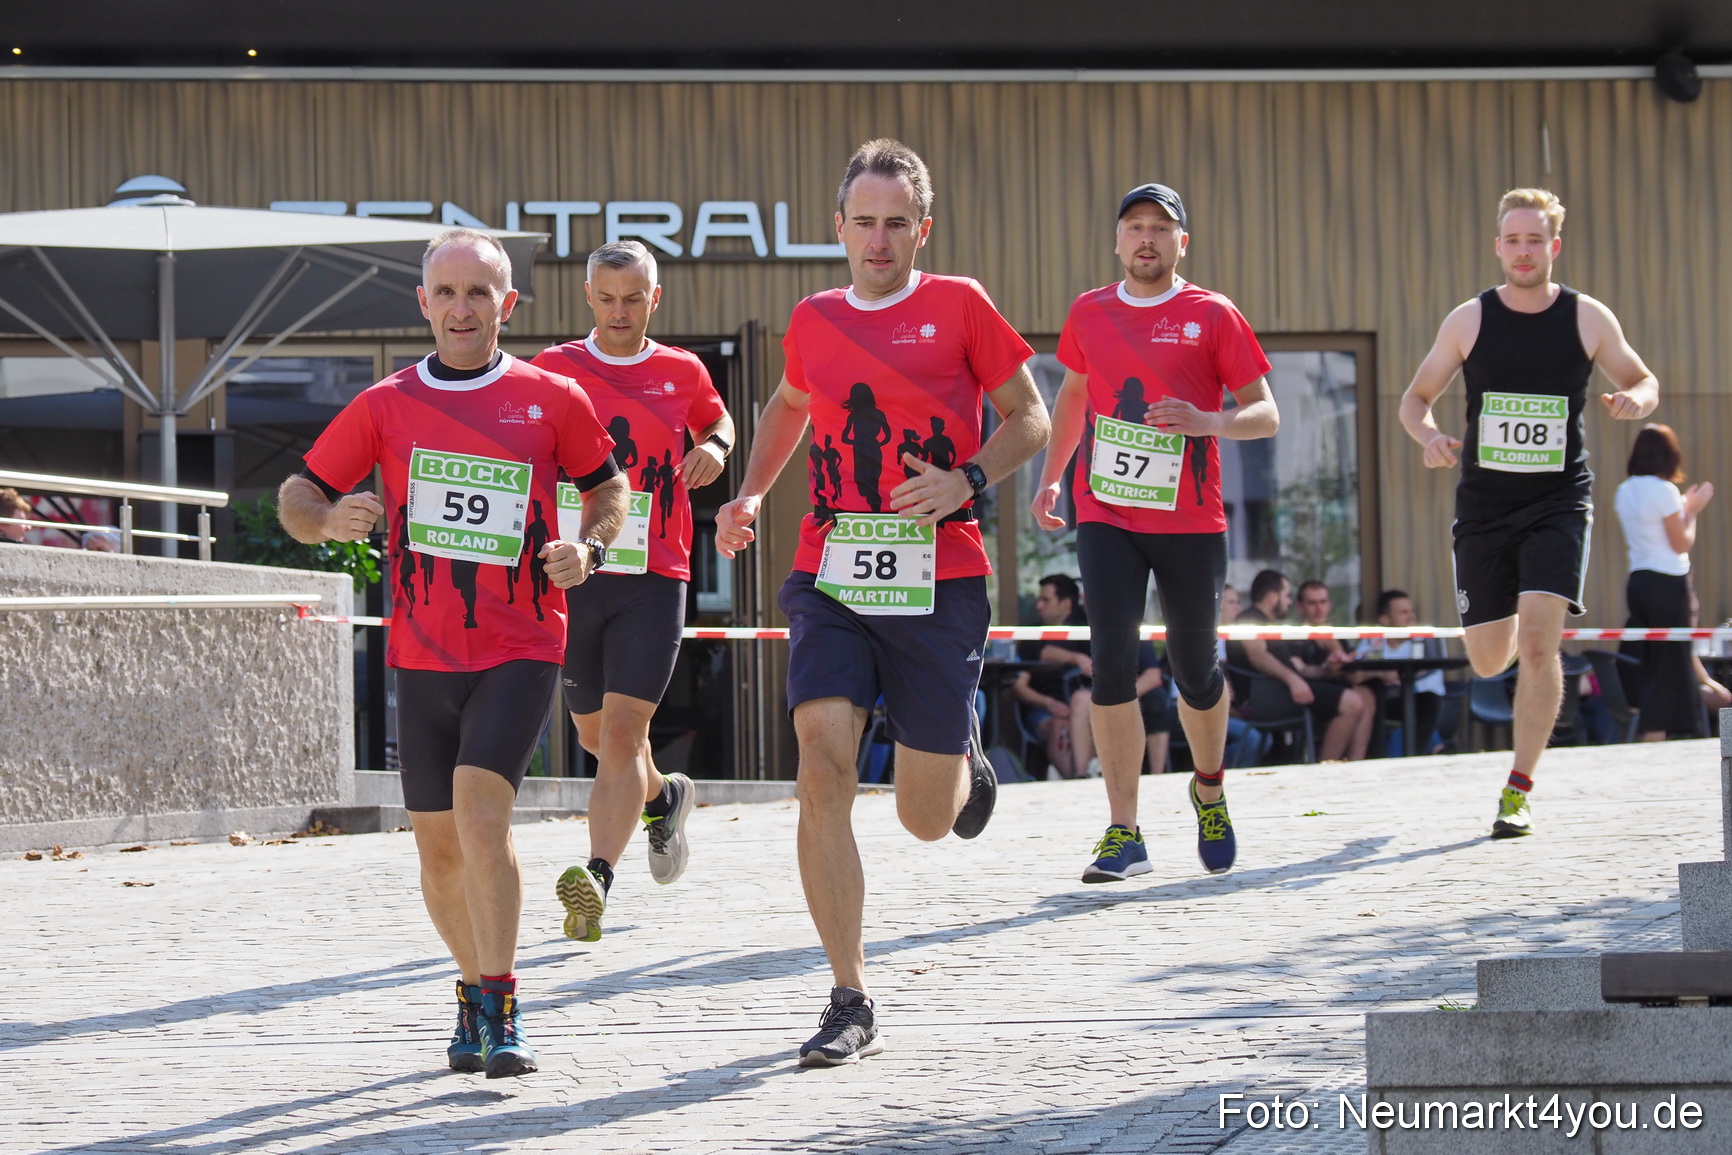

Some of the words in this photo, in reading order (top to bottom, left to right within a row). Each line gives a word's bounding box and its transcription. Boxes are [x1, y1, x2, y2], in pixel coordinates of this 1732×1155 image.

[270, 201, 844, 258] TRAL
[1488, 396, 1560, 416] BOCK
[1101, 420, 1176, 452] BOCK
[1499, 422, 1548, 445] 108
[1114, 451, 1150, 479] 57
[1493, 450, 1549, 463] FLORIAN
[419, 454, 521, 490] BOCK
[1101, 480, 1158, 499] PATRICK
[442, 491, 489, 525] 59
[427, 530, 498, 551] ROLAND
[831, 518, 925, 541] BOCK
[853, 551, 897, 580] 58
[838, 589, 908, 603] MARTIN
